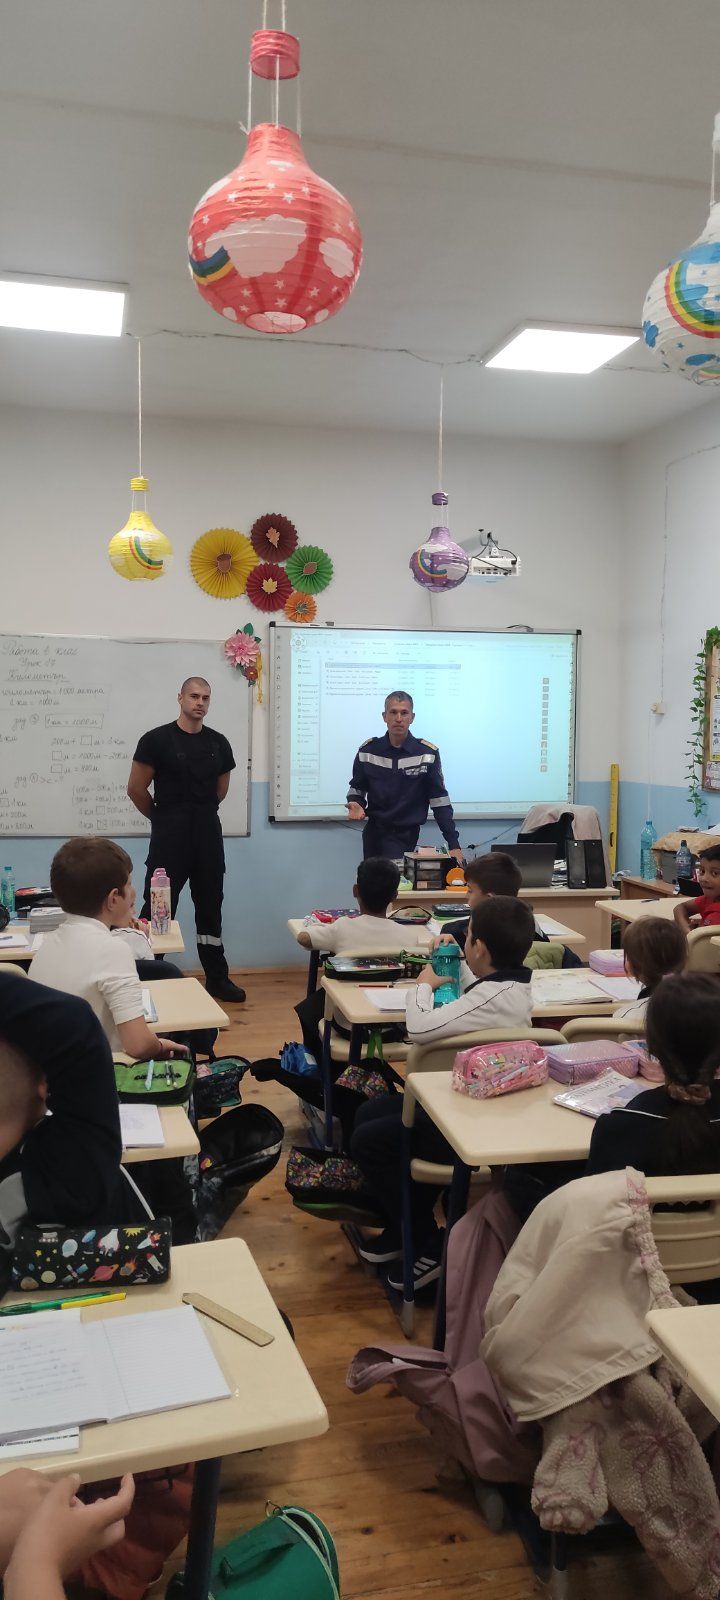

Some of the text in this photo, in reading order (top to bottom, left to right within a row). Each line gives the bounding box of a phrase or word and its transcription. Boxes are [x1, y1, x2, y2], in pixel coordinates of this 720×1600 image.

[2, 640, 40, 656] Работа
[55, 648, 80, 656] клас
[18, 657, 42, 673] Урок
[7, 669, 66, 684] Километър
